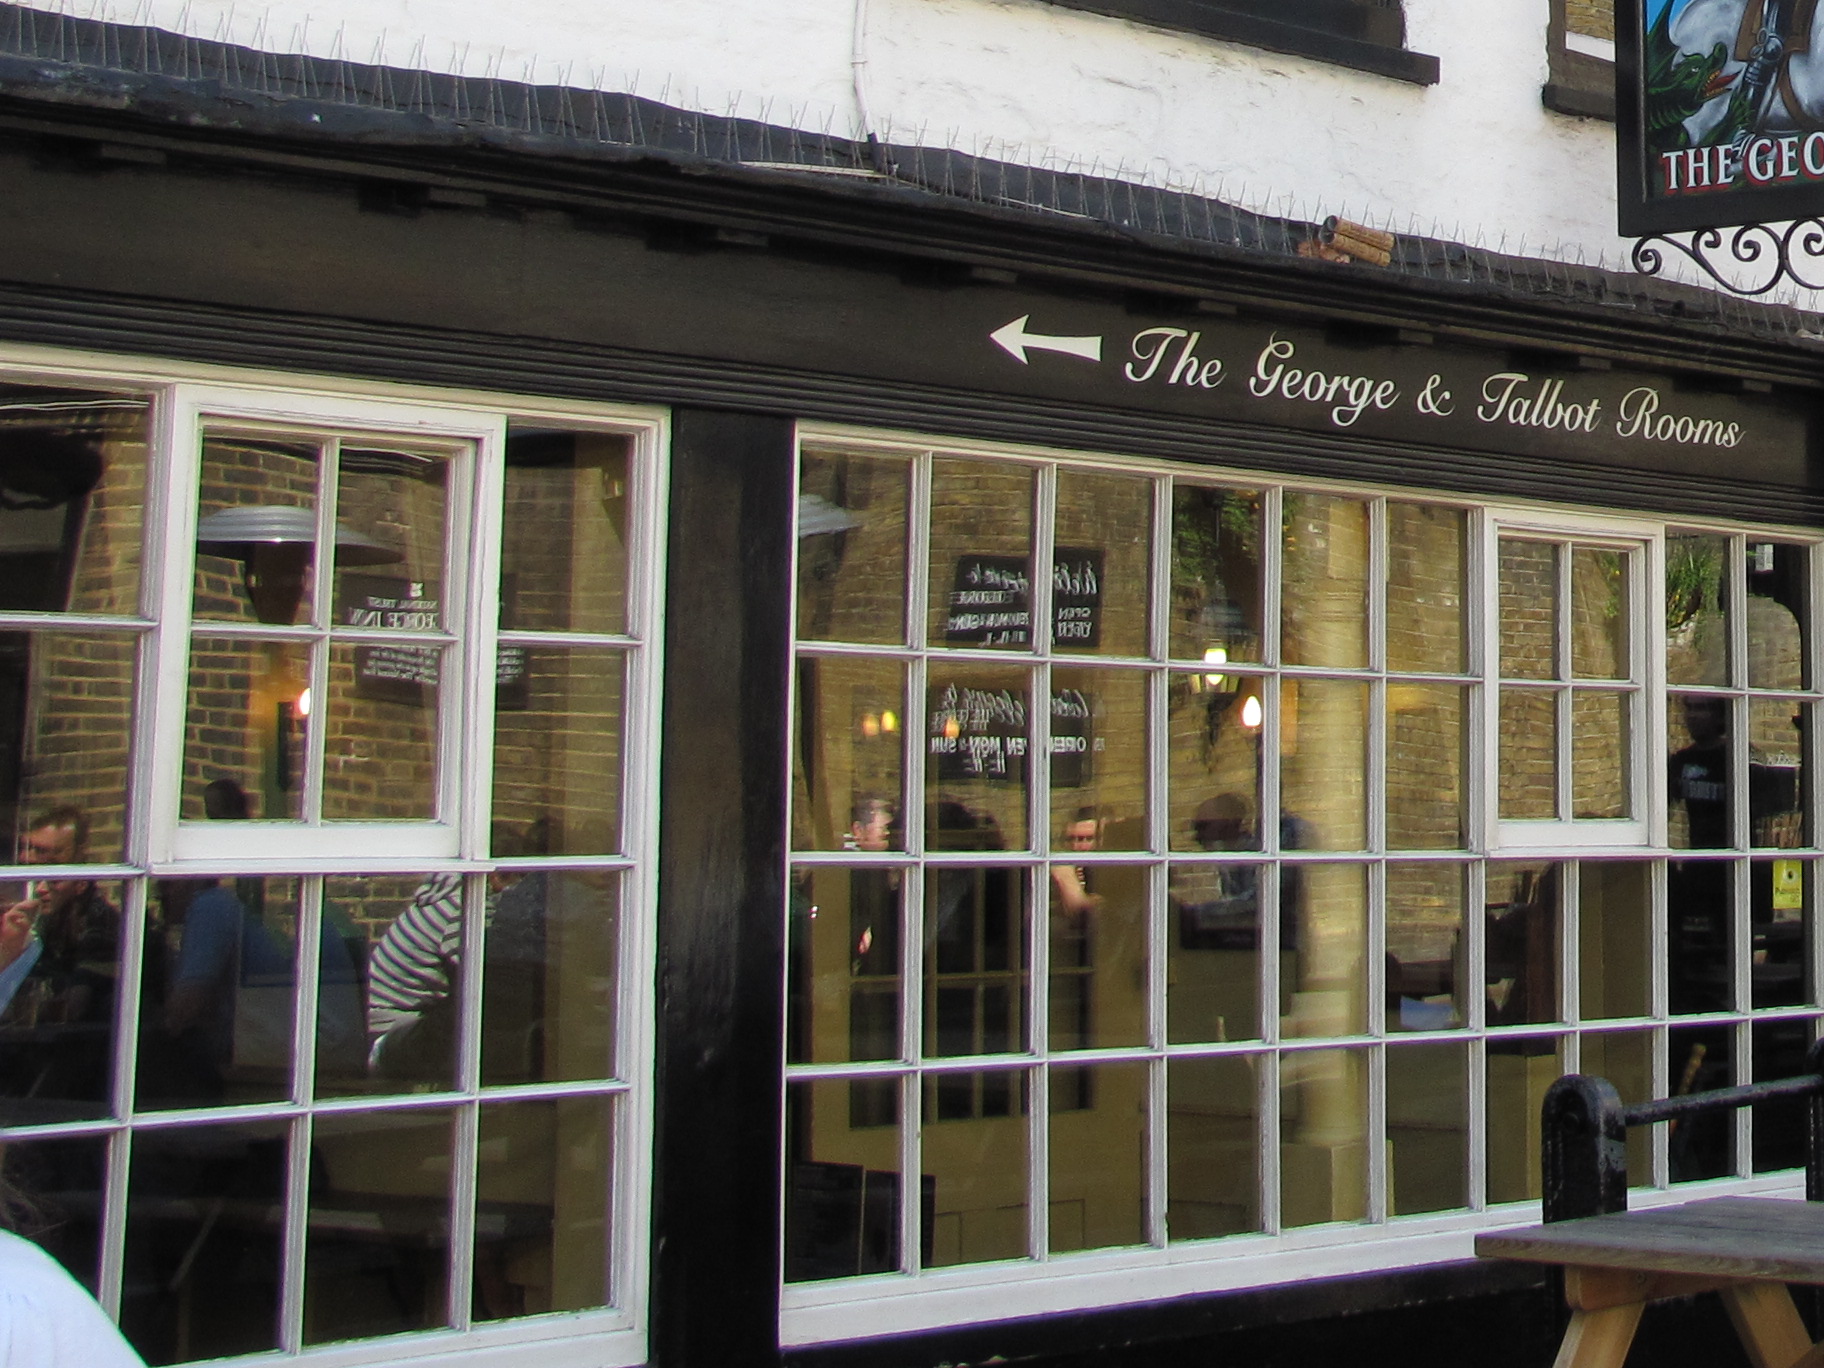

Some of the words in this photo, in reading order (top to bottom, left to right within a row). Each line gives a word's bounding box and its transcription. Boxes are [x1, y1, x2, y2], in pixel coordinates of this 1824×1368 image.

[1661, 143, 1736, 191] THE
[1124, 327, 1226, 389] The
[1249, 330, 1400, 427] George
[1416, 373, 1455, 416] &
[1476, 372, 1602, 433] Talbot
[1616, 386, 1746, 448] Rooms
